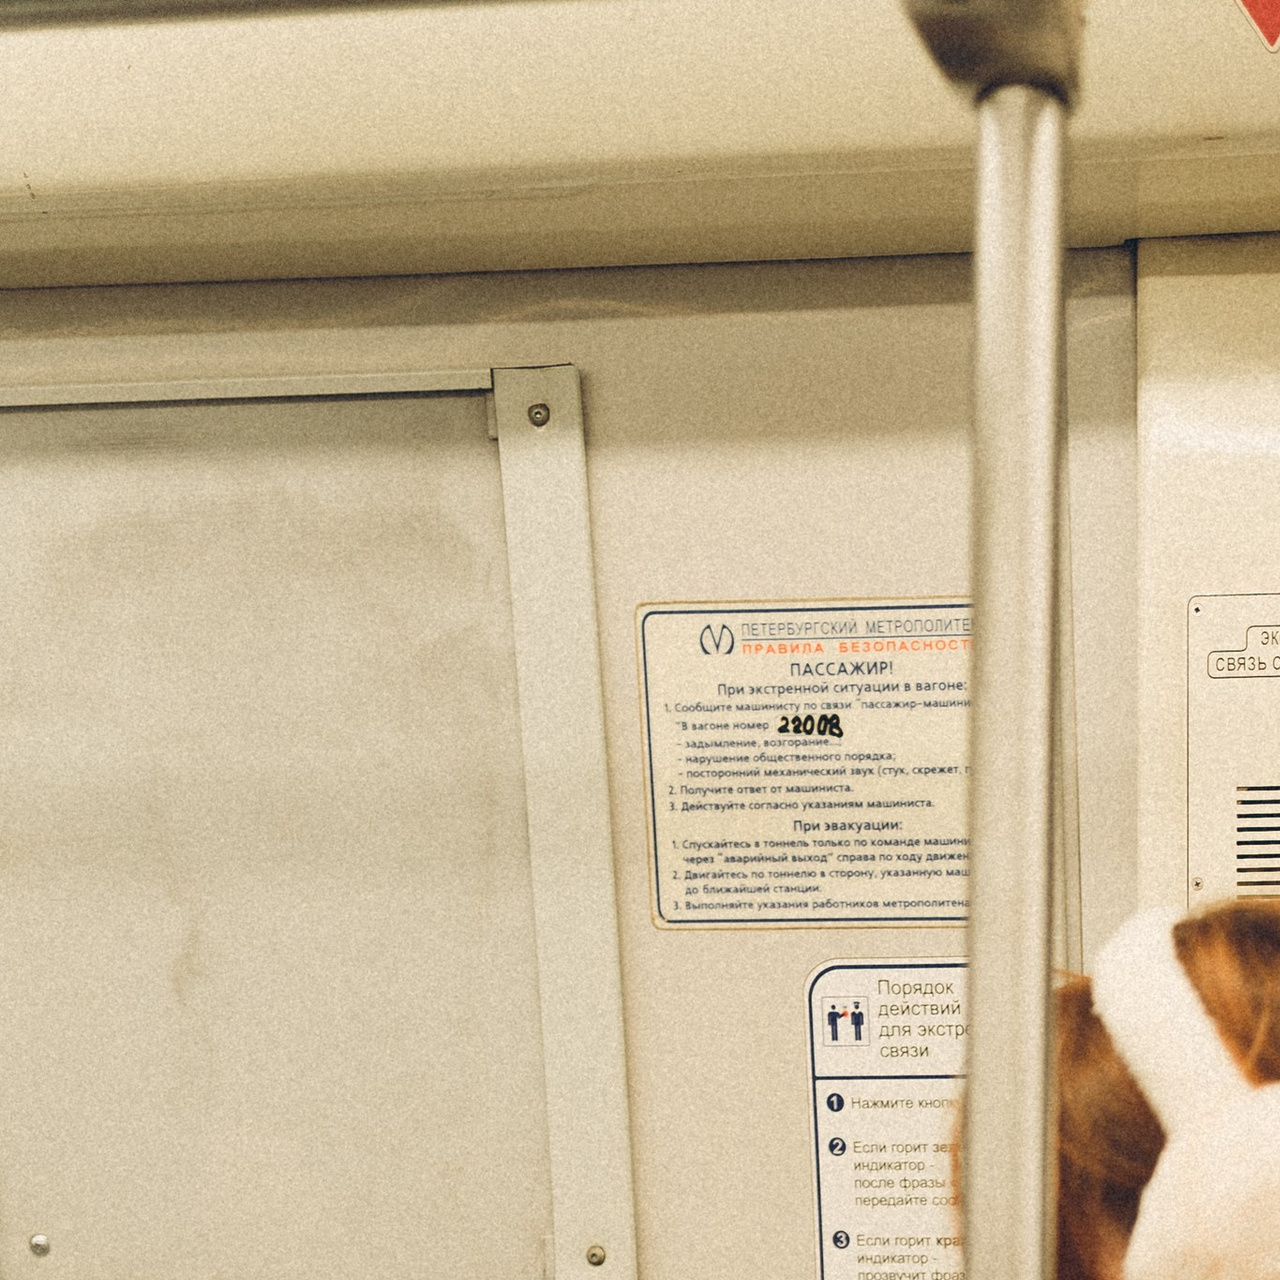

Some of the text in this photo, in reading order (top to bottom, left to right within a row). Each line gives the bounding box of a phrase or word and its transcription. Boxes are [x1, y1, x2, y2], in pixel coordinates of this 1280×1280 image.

[742, 621, 858, 636] ПЕТЕРБУРГСКИЙ
[743, 643, 824, 654] ПРАВИЛА
[790, 662, 893, 676] ПАССАЖИР!
[1216, 656, 1267, 672] СВЯЗЬ
[1272, 656, 1280, 670] С
[718, 681, 967, 696] При экстренной ситуации в вагоне:
[675, 702, 732, 713] Сообщите
[736, 702, 800, 713] машинисту
[804, 702, 817, 710] по
[821, 701, 851, 709] связи
[692, 722, 729, 730] вагоне
[734, 722, 768, 731] номер
[686, 754, 749, 765] нарушение
[753, 751, 841, 763] общественного
[845, 752, 896, 763] порядка;
[687, 767, 760, 779] посторонний
[764, 766, 846, 777] механический
[851, 768, 873, 777] звук
[681, 785, 733, 795] Получите
[737, 786, 767, 794] ответ
[786, 784, 854, 793] машиниста.
[681, 800, 745, 811] Действуйте
[749, 801, 798, 810] согласно
[802, 800, 863, 811] указаниям
[868, 800, 934, 809] машиниста.
[793, 820, 902, 833] При эвакуации:
[682, 839, 751, 850] Спускайтесь
[764, 840, 809, 848] тоннель
[813, 839, 850, 847] только
[855, 839, 867, 847] по
[871, 838, 920, 848] команде
[683, 854, 714, 864] через
[837, 854, 875, 863] справа
[880, 853, 892, 861] по
[896, 853, 922, 864] ходу
[685, 869, 748, 881] Двигайтесь
[752, 871, 764, 879] по
[768, 870, 816, 879] тоннелю
[880, 868, 942, 879] указанную
[685, 886, 698, 895] до
[703, 883, 769, 893] ближайшей
[685, 899, 753, 911] Выполняйте
[757, 901, 808, 911] указания
[812, 898, 878, 909] работников
[878, 979, 954, 997] Порядок
[879, 999, 960, 1016] действий
[880, 1021, 912, 1037] для
[880, 1044, 929, 1058] связи
[852, 1097, 913, 1110] Нажмите
[853, 1142, 887, 1154] Если
[892, 1143, 927, 1155] горит
[854, 1160, 925, 1173] индикатор
[855, 1178, 894, 1188] после
[900, 1176, 945, 1190] фразы
[856, 1194, 927, 1207] передайте
[857, 1235, 889, 1246] Если
[895, 1237, 929, 1248] горит
[858, 1254, 928, 1265] индикатор
